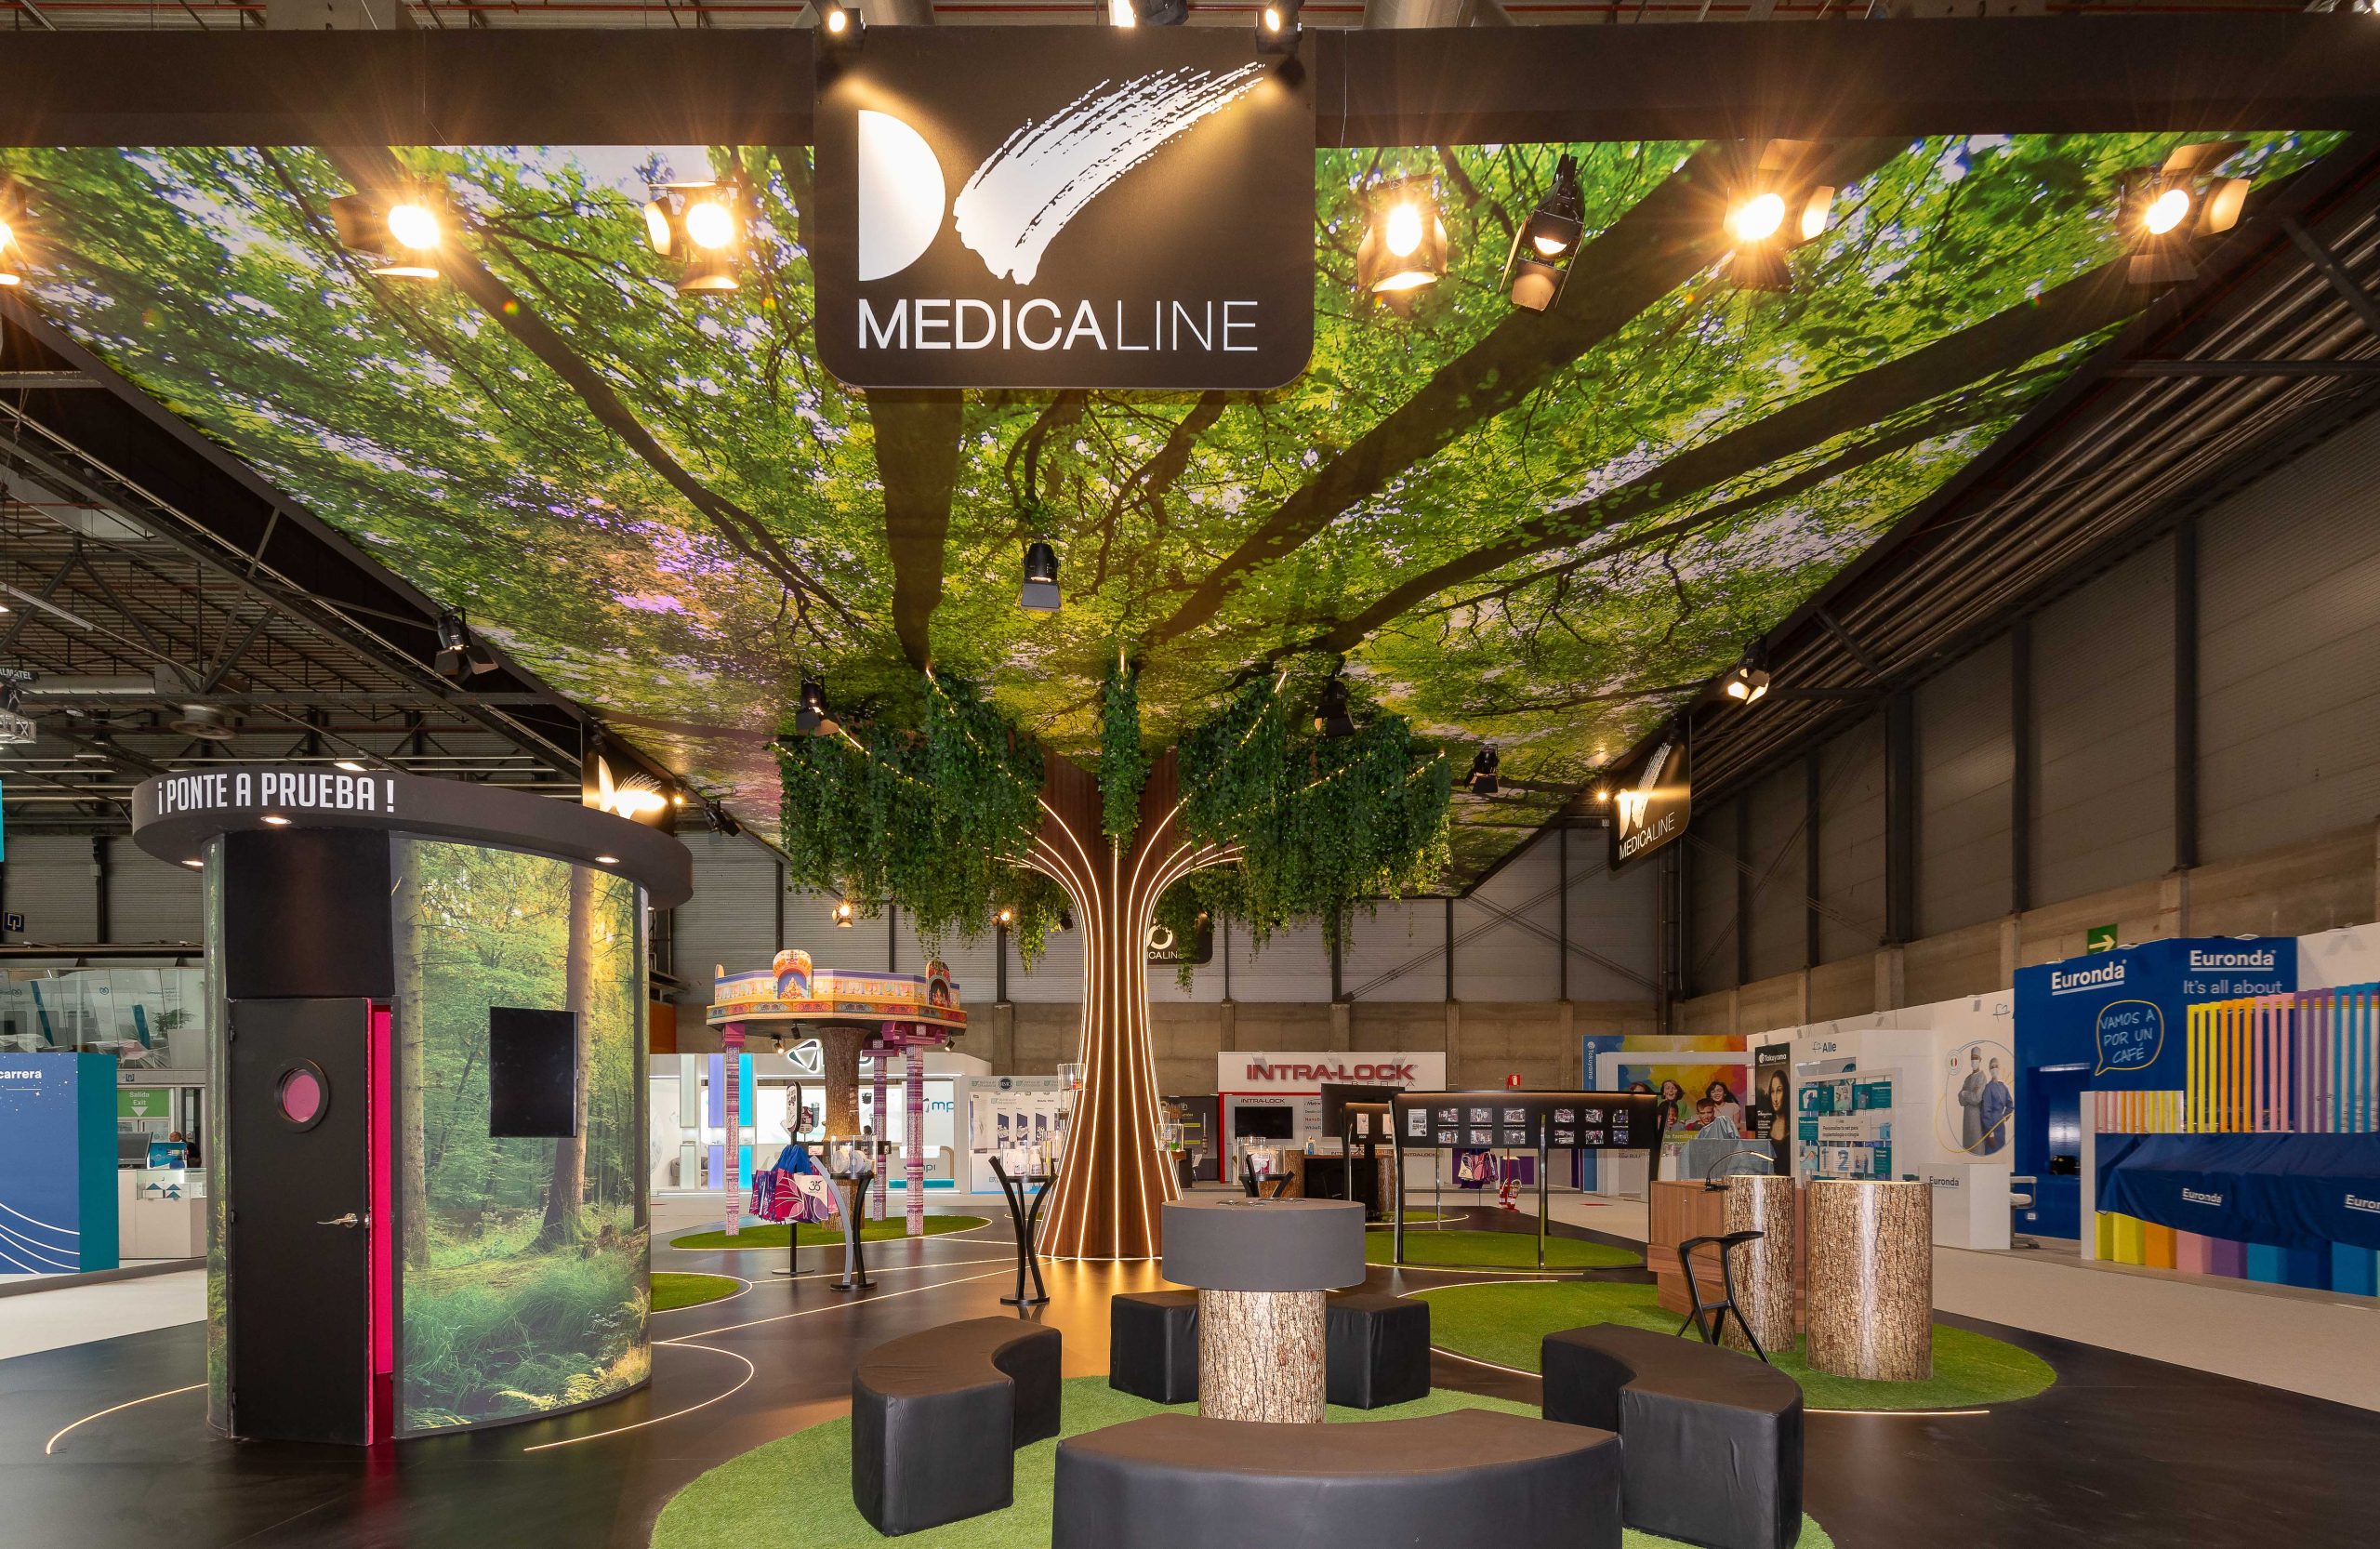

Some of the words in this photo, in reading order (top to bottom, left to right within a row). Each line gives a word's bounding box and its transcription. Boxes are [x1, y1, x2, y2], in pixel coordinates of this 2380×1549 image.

[858, 298, 1258, 351] MEDICALINE
[235, 773, 252, 807] A
[261, 773, 375, 812] PRUEBA
[1619, 811, 1675, 861] MEDICALINE
[2211, 979, 2228, 995] all
[2233, 980, 2282, 995] about
[2099, 1012, 2141, 1029] VAMOS
[2145, 1008, 2156, 1022] A
[2103, 1031, 2129, 1047] POR
[2135, 1027, 2153, 1042] UN
[1822, 1042, 1837, 1053] Alle
[2111, 1043, 2145, 1064] CAFÉ
[1929, 1175, 1960, 1186] Euronda
[2182, 1187, 2223, 1204] Euronda
